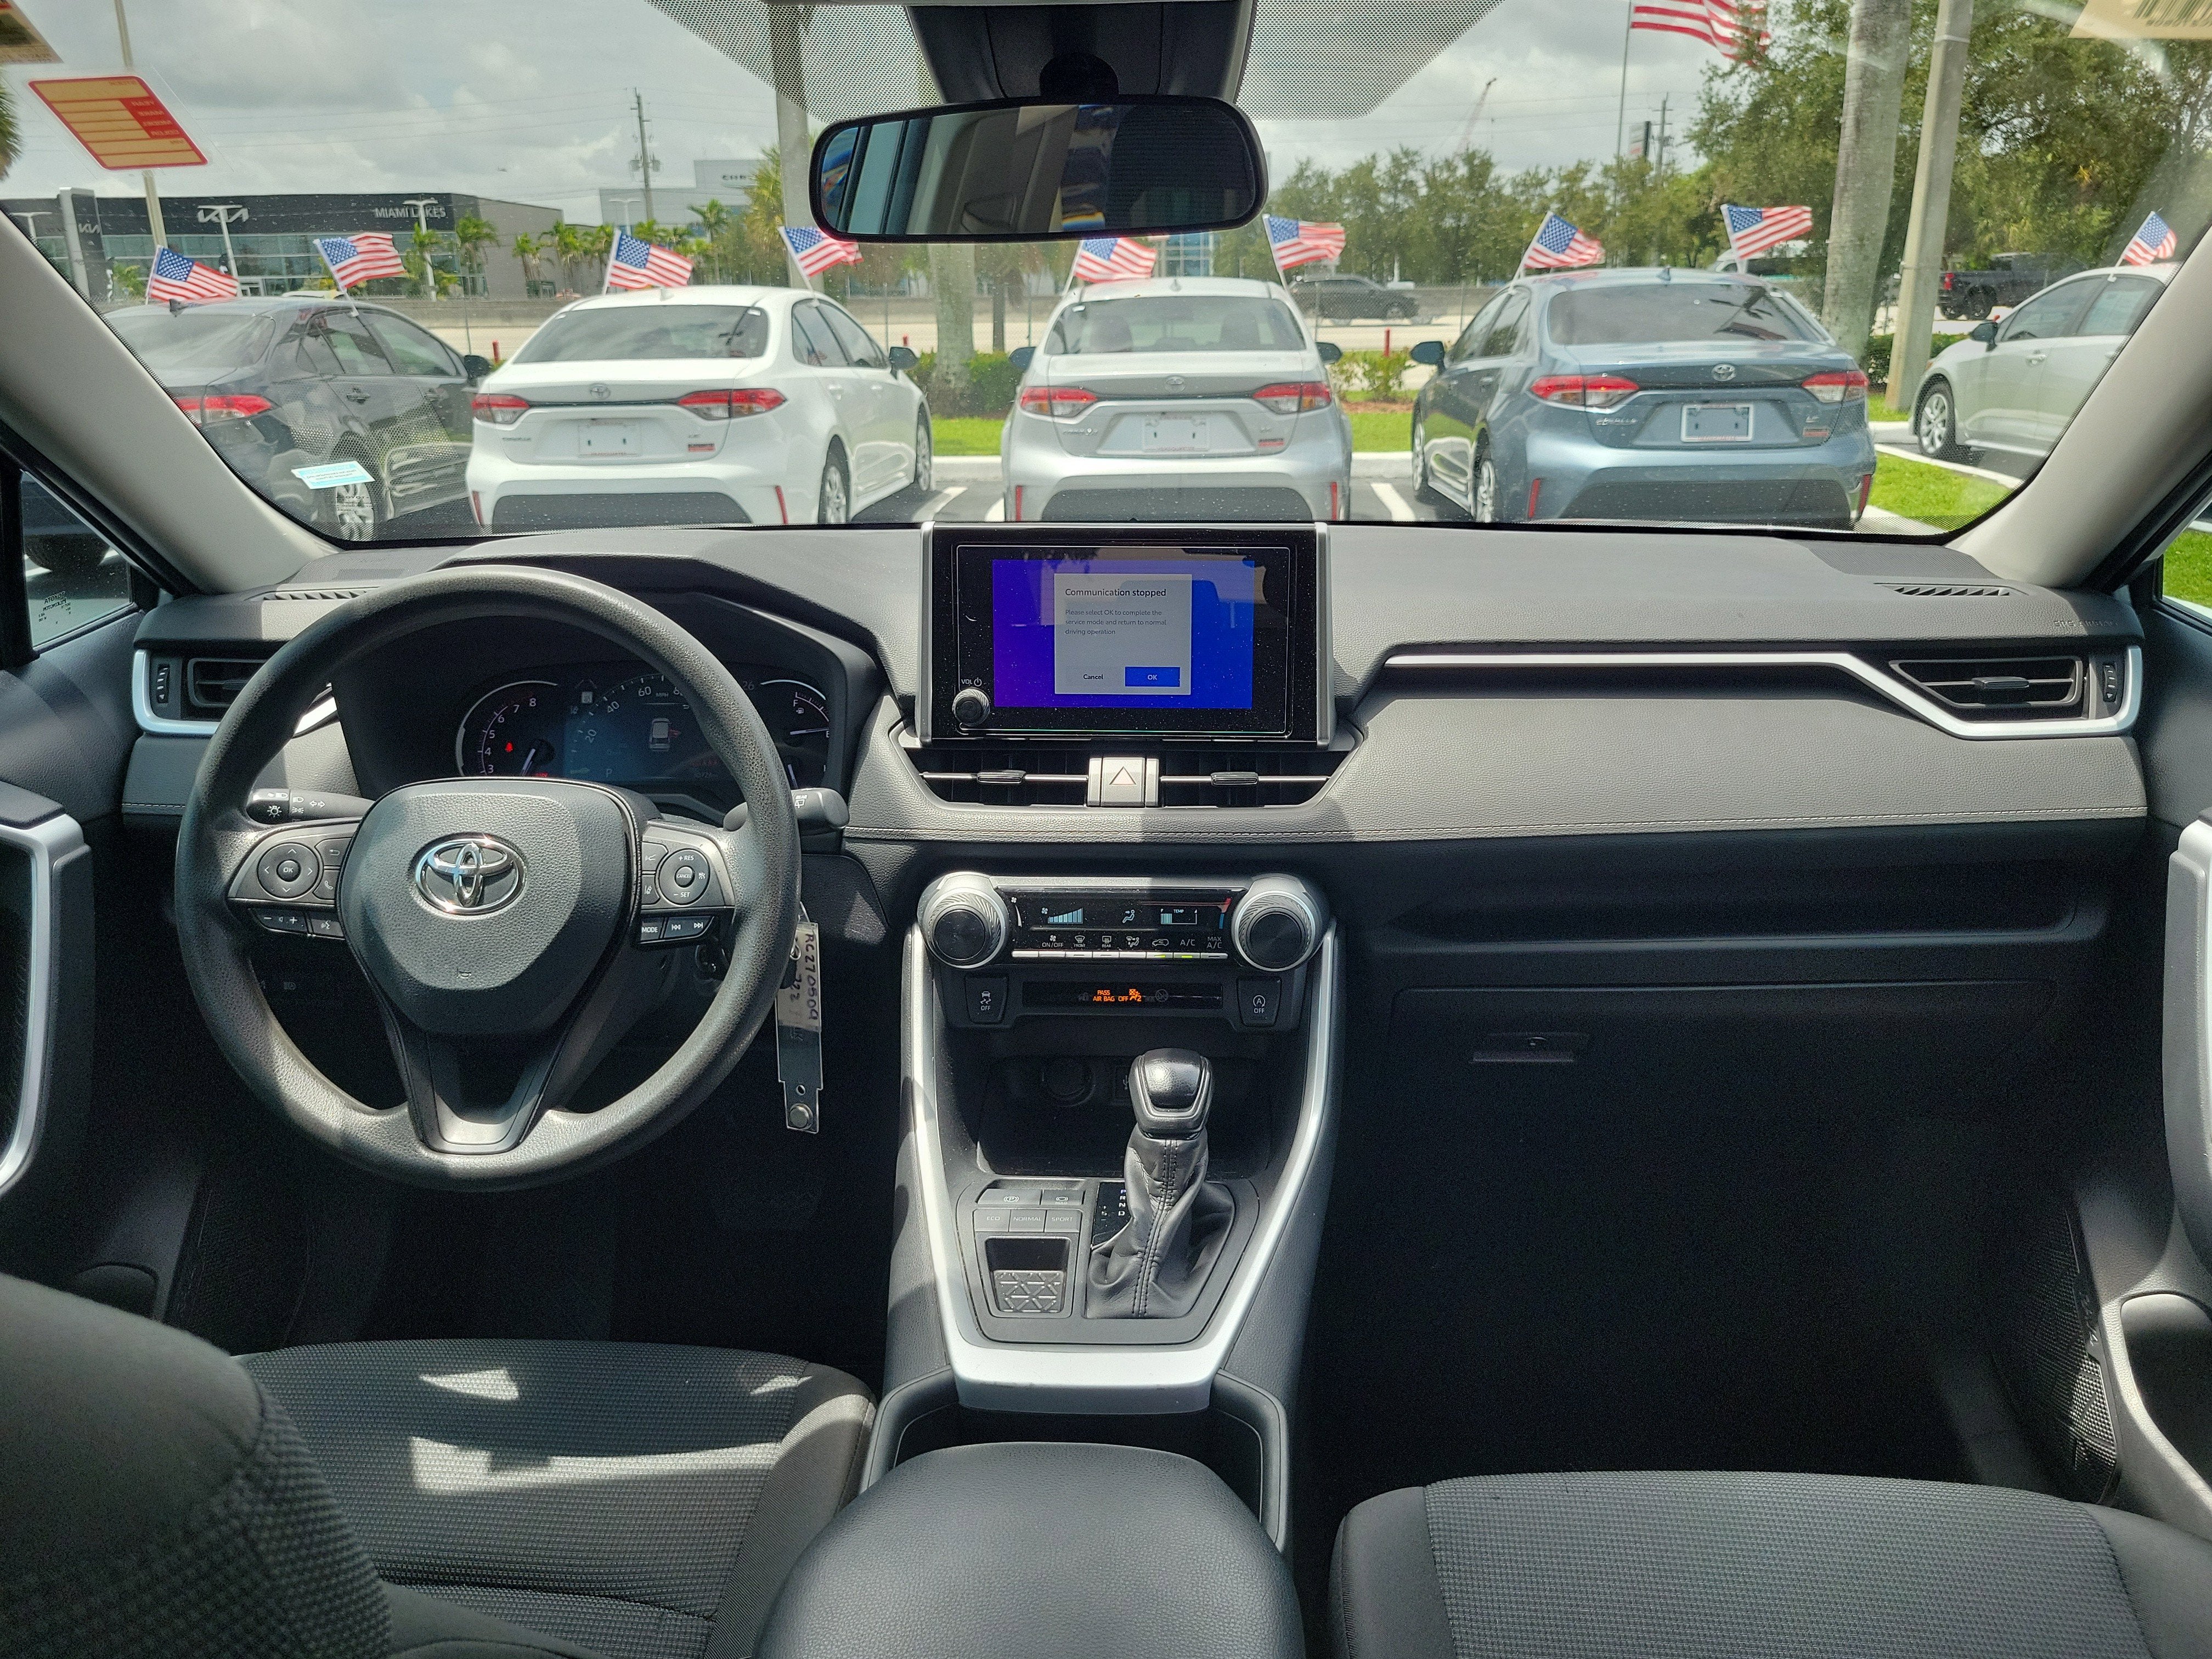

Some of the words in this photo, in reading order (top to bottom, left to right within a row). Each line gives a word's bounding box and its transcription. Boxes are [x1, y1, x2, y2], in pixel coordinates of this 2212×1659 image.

[375, 207, 409, 218] MIAMI
[411, 206, 446, 218] LKES
[1065, 588, 1130, 596] Communication
[1132, 589, 1166, 598] stopped
[638, 686, 652, 697] 60
[529, 698, 537, 707] 8
[607, 701, 619, 713] 40
[514, 704, 520, 713] 7
[489, 730, 495, 738] 5
[585, 729, 597, 743] 20
[484, 747, 491, 755] 4
[488, 765, 494, 773] 3
[283, 866, 294, 874] OK
